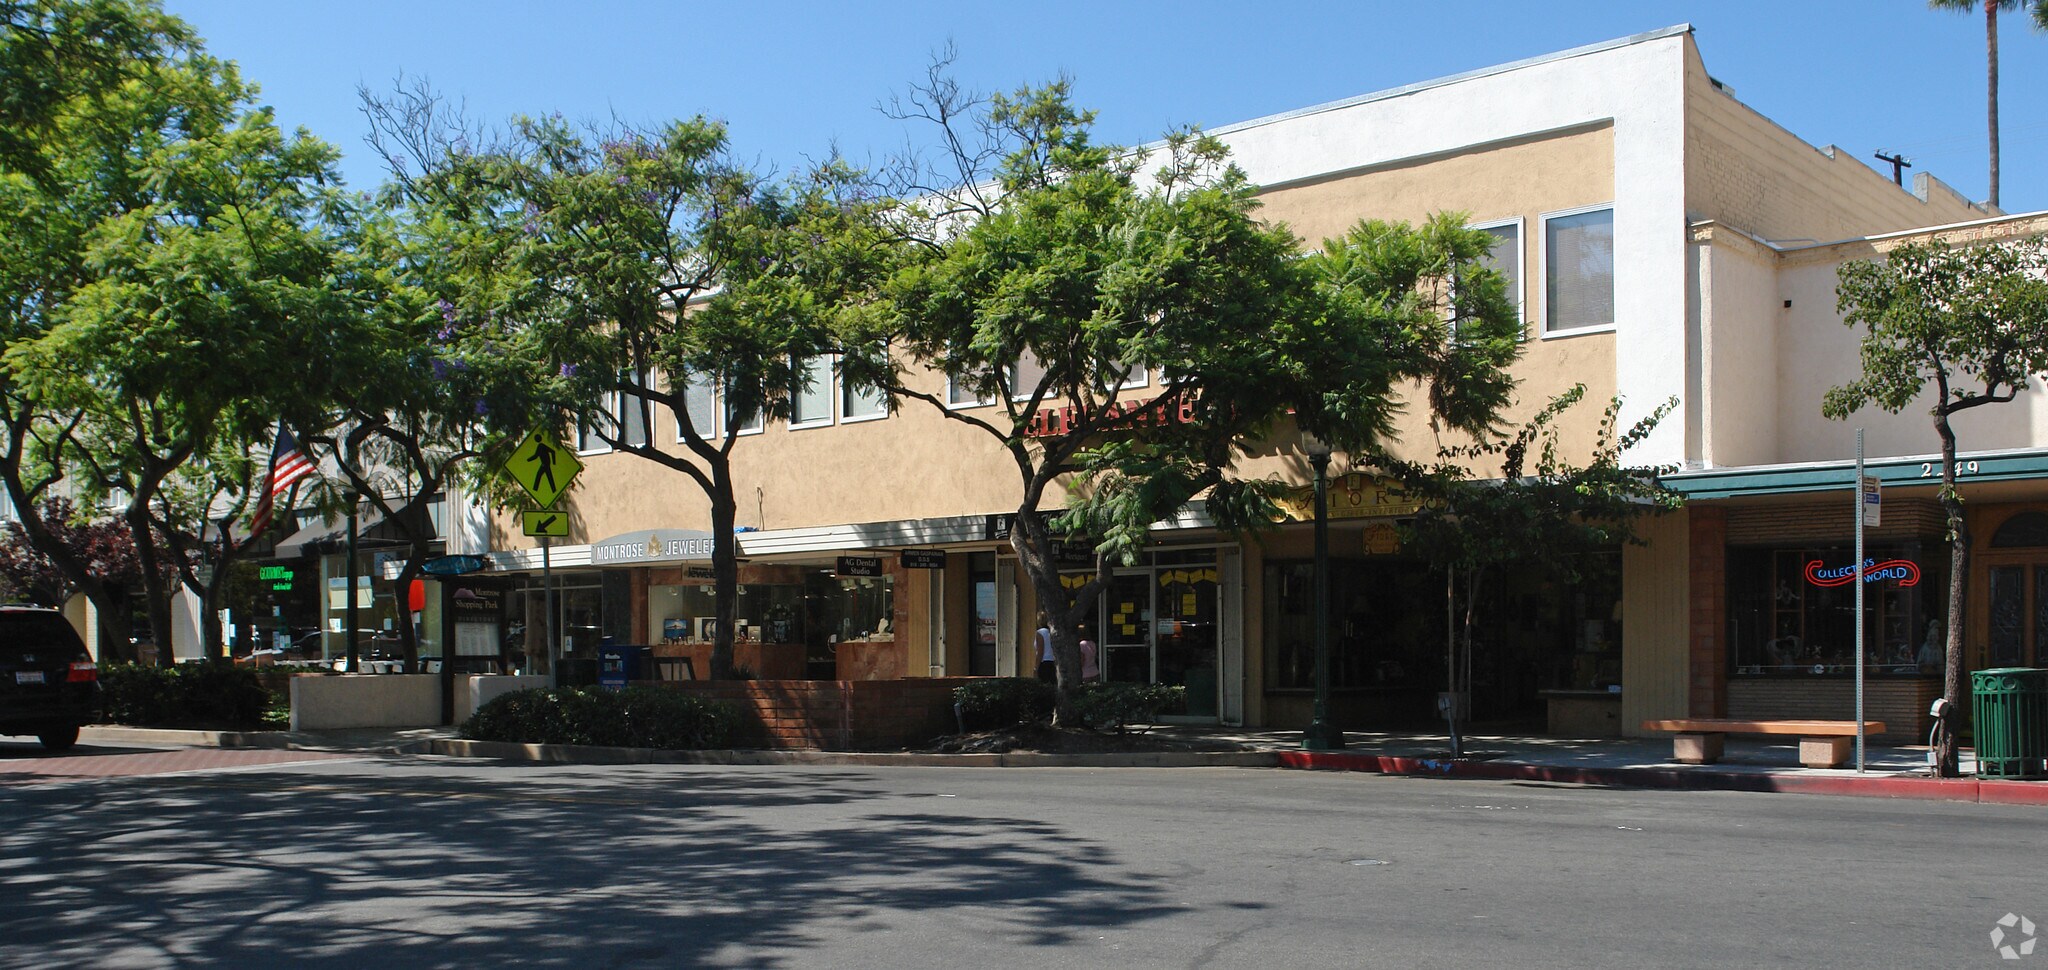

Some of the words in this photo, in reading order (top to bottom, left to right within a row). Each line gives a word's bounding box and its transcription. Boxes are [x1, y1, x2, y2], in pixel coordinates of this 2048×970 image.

[1921, 461, 1979, 478] 249
[597, 544, 643, 560] MONTROSE
[845, 558, 854, 566] AG
[856, 559, 877, 567] Dental
[850, 567, 870, 575] Studio
[1863, 567, 1907, 583] WORLD
[475, 588, 500, 597] Montrose
[455, 600, 483, 609] Shopping
[484, 600, 498, 609] Park
